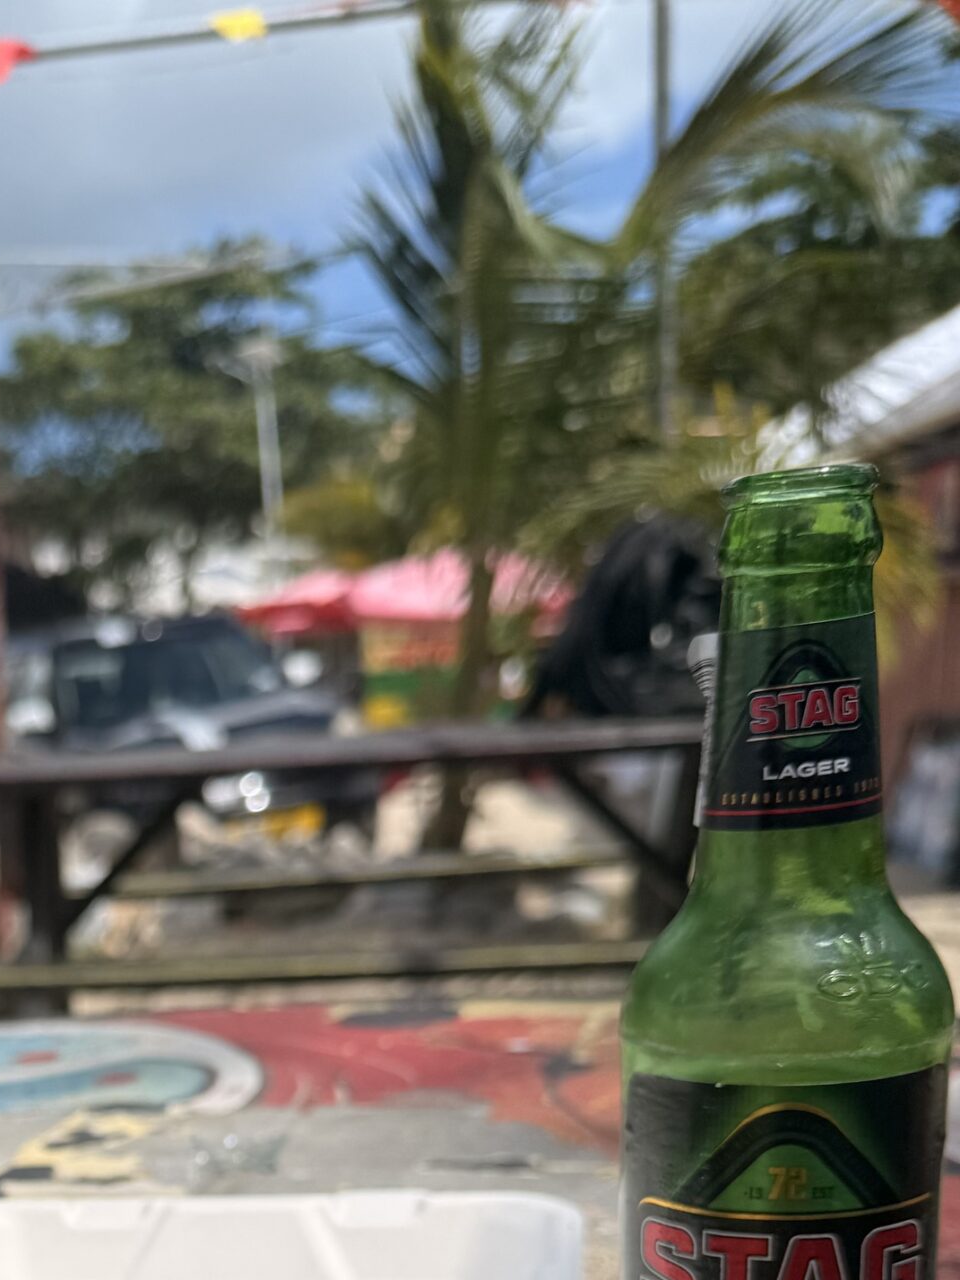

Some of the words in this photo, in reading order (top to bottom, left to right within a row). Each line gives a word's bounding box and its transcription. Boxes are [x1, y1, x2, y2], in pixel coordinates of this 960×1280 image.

[749, 686, 860, 734] STAG
[762, 757, 851, 781] LAGER
[767, 1167, 807, 1200] 72
